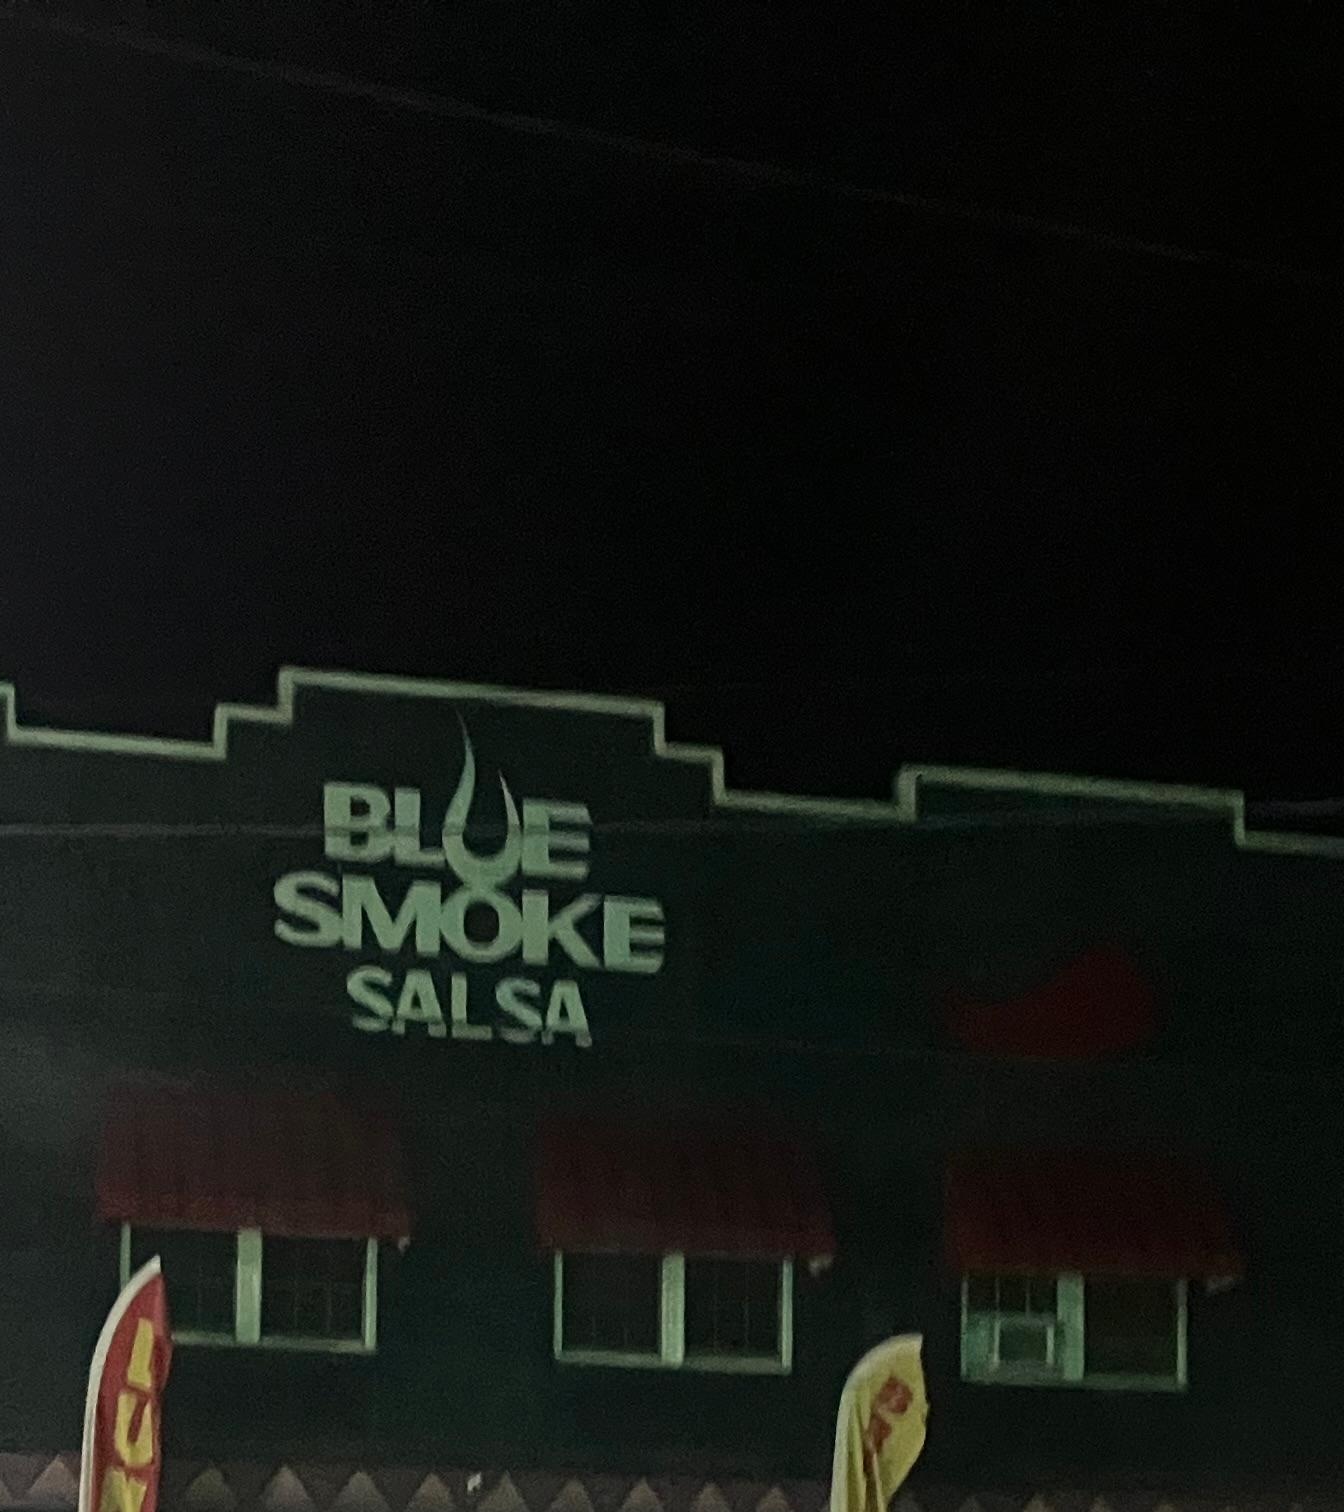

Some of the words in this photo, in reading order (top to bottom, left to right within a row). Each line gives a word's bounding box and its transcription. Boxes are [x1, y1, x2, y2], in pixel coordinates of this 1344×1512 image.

[322, 768, 594, 890] BLUE
[272, 868, 667, 975] SMOKE
[345, 963, 594, 1048] SALSA
